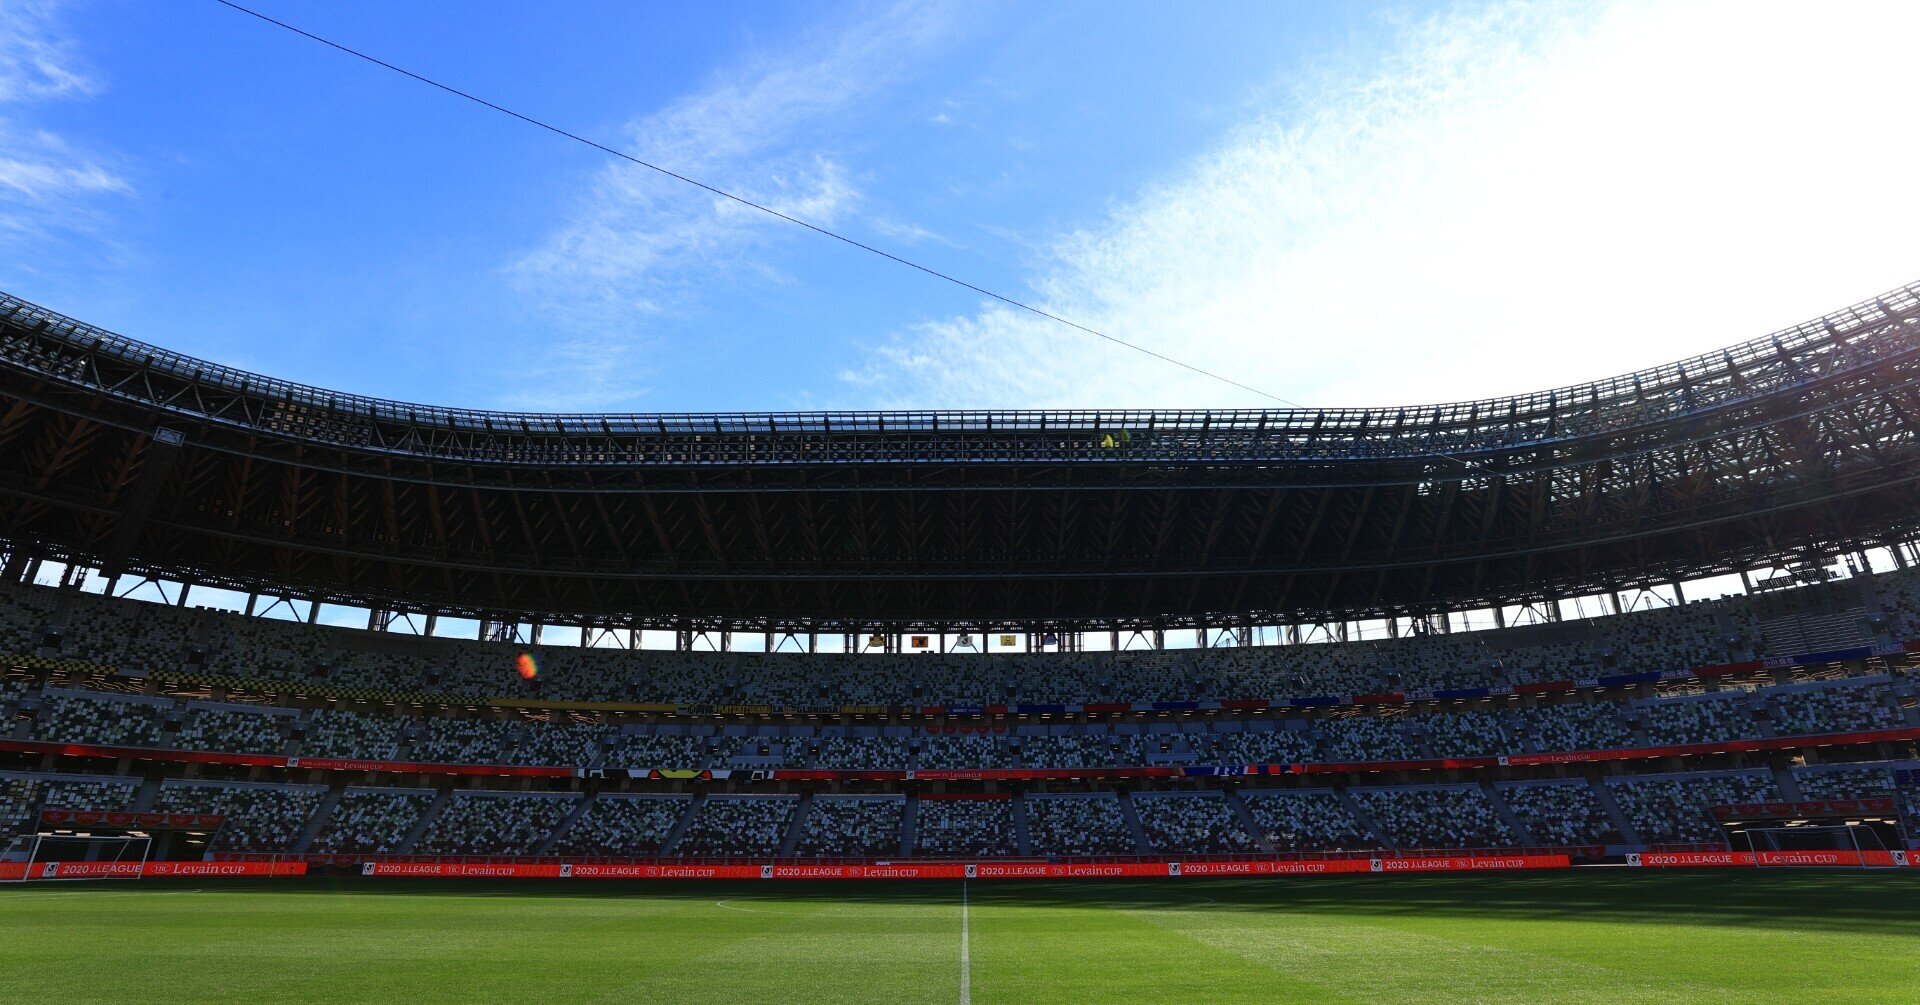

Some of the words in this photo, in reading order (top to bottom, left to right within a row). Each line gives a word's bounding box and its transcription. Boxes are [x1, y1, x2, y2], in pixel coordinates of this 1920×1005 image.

[1648, 856, 1678, 864] 2020
[1680, 855, 1733, 863] J.LEAGUE
[1762, 853, 1812, 864] Levain
[1814, 855, 1838, 863] CUP
[63, 865, 90, 874] 2020
[90, 864, 141, 873] J.LEAGUE
[173, 863, 220, 874] Levain
[221, 865, 245, 874] CUP
[1185, 864, 1208, 872] 2020
[1209, 864, 1250, 872] J.LEAGUE
[1271, 863, 1305, 872] Levain
[1306, 864, 1326, 872] CUP
[1386, 861, 1409, 869] 2020
[1410, 860, 1451, 868] J.LEAGUE
[1471, 859, 1506, 868] Levain
[1507, 860, 1525, 868] CUP
[461, 865, 495, 875] Levain
[496, 867, 516, 875] CUP
[576, 867, 599, 875] 2020
[600, 867, 640, 875] J.LEAGUE
[660, 866, 695, 876] Levain
[697, 869, 716, 877] CUP
[777, 868, 800, 876] 2020
[801, 868, 843, 876] J.LEAGUE
[863, 867, 900, 877] Levain
[901, 869, 919, 877] CUP
[980, 867, 1004, 875] 2020
[1005, 867, 1047, 875] J.LEAGUE
[1067, 866, 1103, 876] Levain
[1104, 868, 1122, 876] CUP
